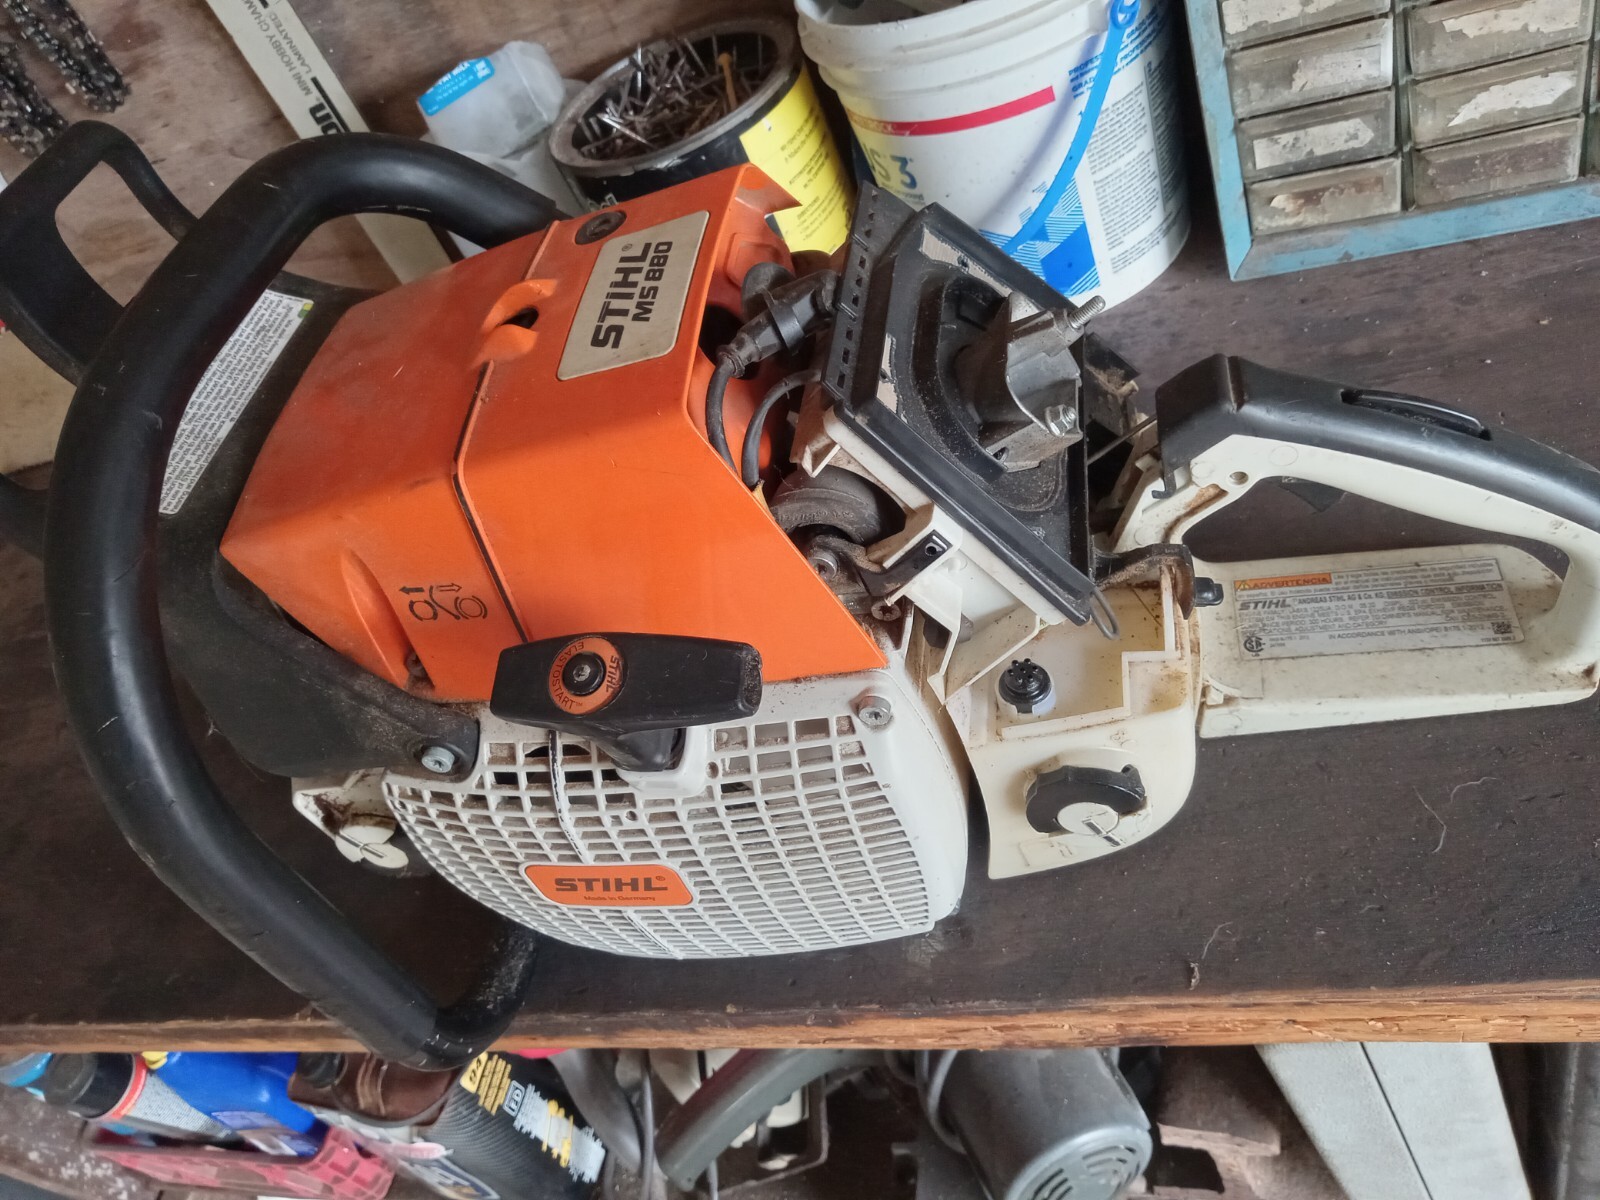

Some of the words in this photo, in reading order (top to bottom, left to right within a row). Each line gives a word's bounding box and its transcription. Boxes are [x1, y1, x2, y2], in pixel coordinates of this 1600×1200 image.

[266, 34, 296, 72] HOBBY
[292, 72, 313, 96] MINI
[890, 154, 917, 189] 3
[591, 242, 652, 348] STIHL
[632, 286, 658, 321] MS
[645, 241, 673, 281] 880
[1253, 576, 1330, 588] ADVERTENCIA
[1238, 598, 1291, 611] STIHL
[606, 655, 620, 692] STIHL
[555, 877, 668, 892] STIHL
